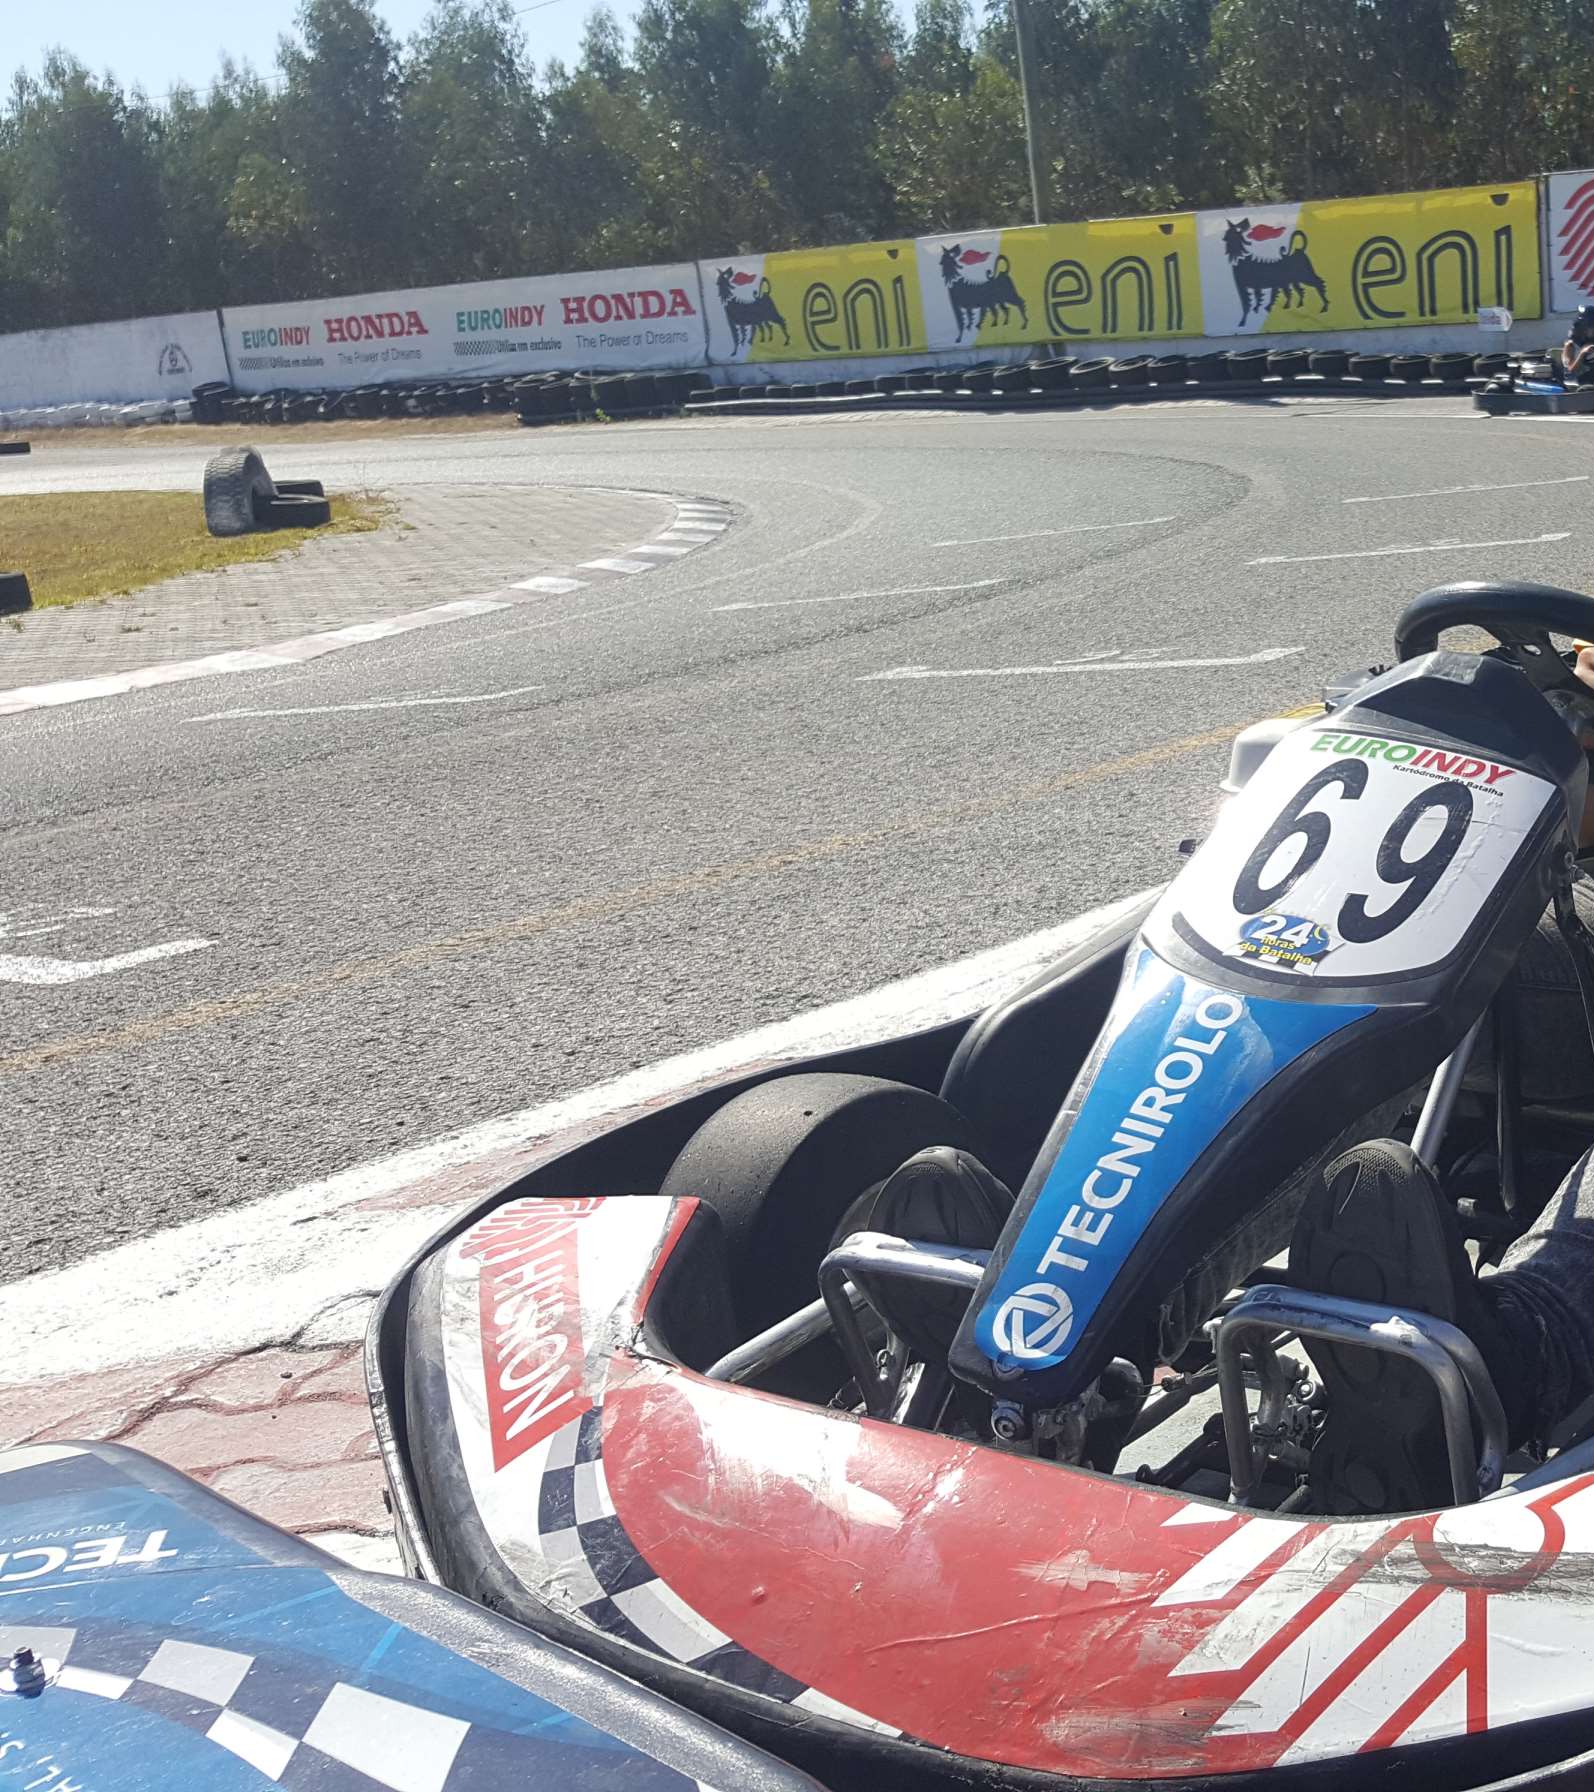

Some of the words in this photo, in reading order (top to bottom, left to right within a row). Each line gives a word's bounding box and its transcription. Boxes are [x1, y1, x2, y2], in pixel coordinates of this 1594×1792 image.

[1352, 193, 1514, 320] eni
[1044, 224, 1183, 336] eni
[456, 304, 546, 332] EUROINDY
[559, 288, 696, 325] HONDA
[802, 249, 911, 353] eni
[242, 326, 311, 350] EUROINDY
[324, 311, 429, 343] HONDA
[576, 334, 597, 348] The
[599, 334, 630, 348] Power
[645, 331, 688, 345] Dreams
[1310, 734, 1516, 784] EUROINDY
[1393, 764, 1450, 783] Kartódromo
[1467, 781, 1504, 797] Batalha
[1233, 758, 1475, 944] 69
[1250, 914, 1316, 948] 24
[1260, 945, 1314, 966] Batalha
[1036, 993, 1244, 1275] TECNIROLO
